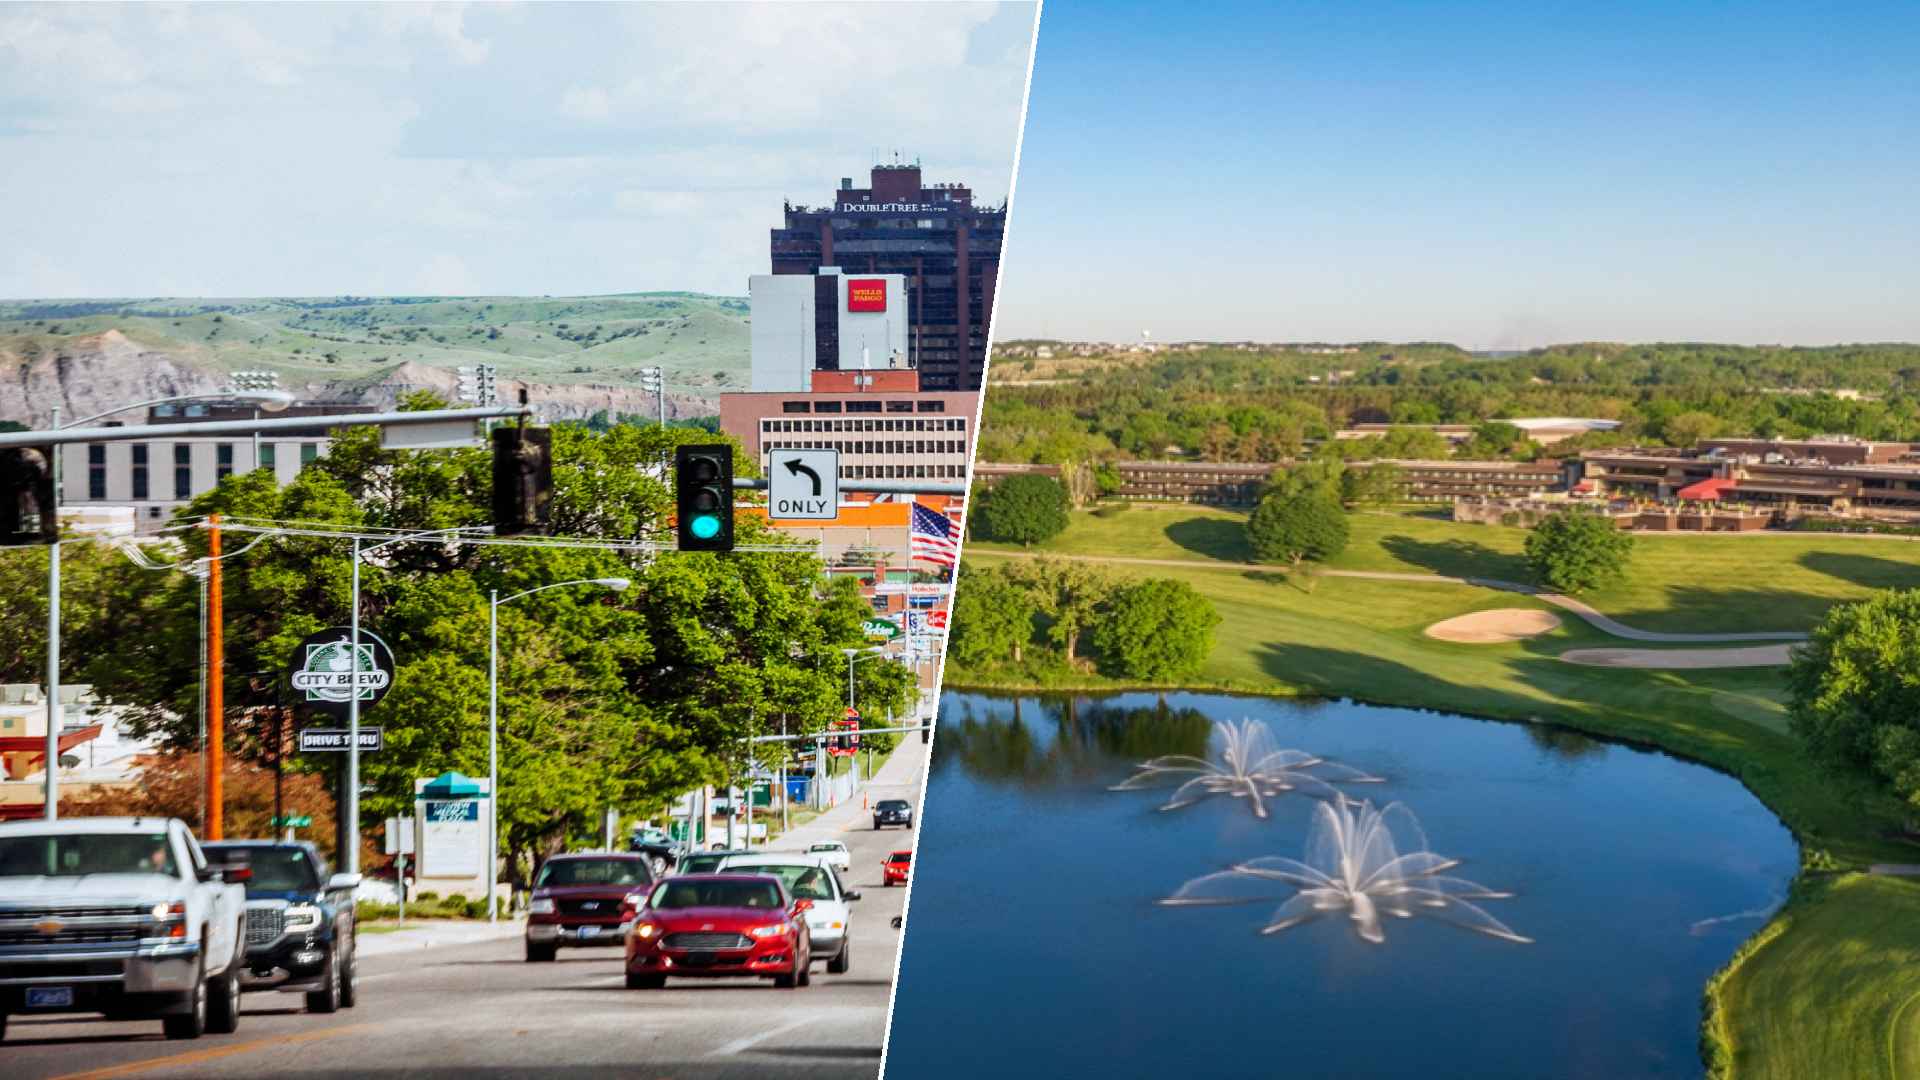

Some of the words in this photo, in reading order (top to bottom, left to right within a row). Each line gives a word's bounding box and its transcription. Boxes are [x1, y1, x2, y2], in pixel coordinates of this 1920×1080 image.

[778, 499, 828, 513] ONLY
[297, 674, 332, 685] CITY
[303, 735, 339, 746] DRIVE
[343, 735, 377, 745] TRU
